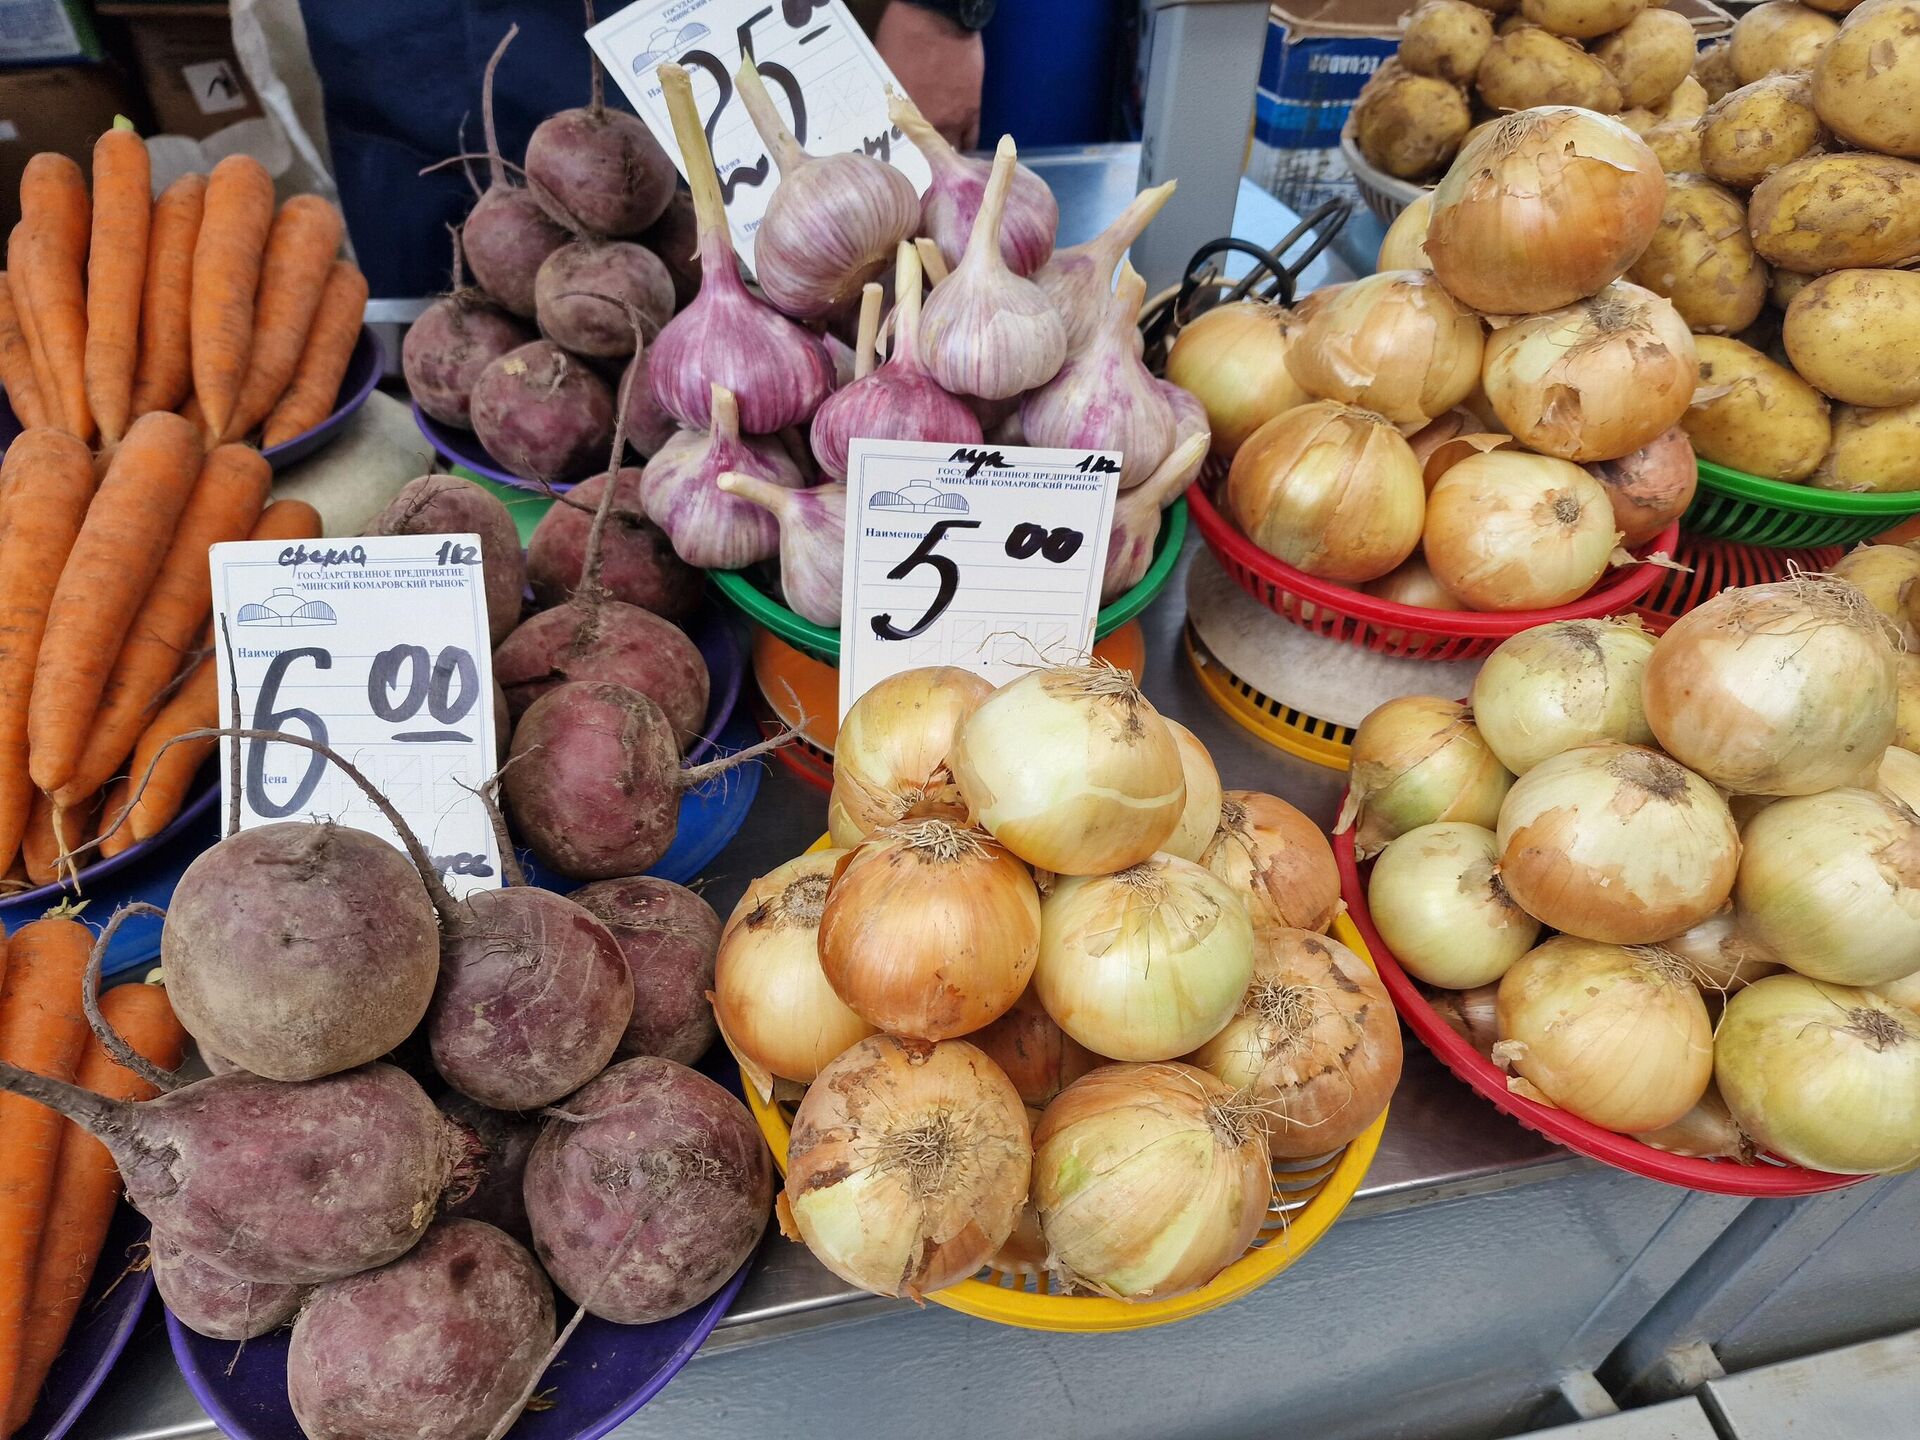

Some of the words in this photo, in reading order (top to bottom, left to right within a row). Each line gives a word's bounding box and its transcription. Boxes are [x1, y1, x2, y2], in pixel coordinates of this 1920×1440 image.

[1033, 472, 1100, 482] ПРЕДПРИЯТИЕ
[991, 480, 1062, 490] КОМАРОВСКИЙ
[297, 570, 392, 580] ГОСУДАРСТВЕННОЕ
[395, 568, 464, 578] ПРЕДПРИЯТИЕ
[353, 579, 427, 589] КОМАРОВСКИЙ
[871, 520, 982, 640] 5
[1005, 522, 1084, 563] 00
[247, 647, 332, 818] 6
[368, 644, 479, 724] 00
